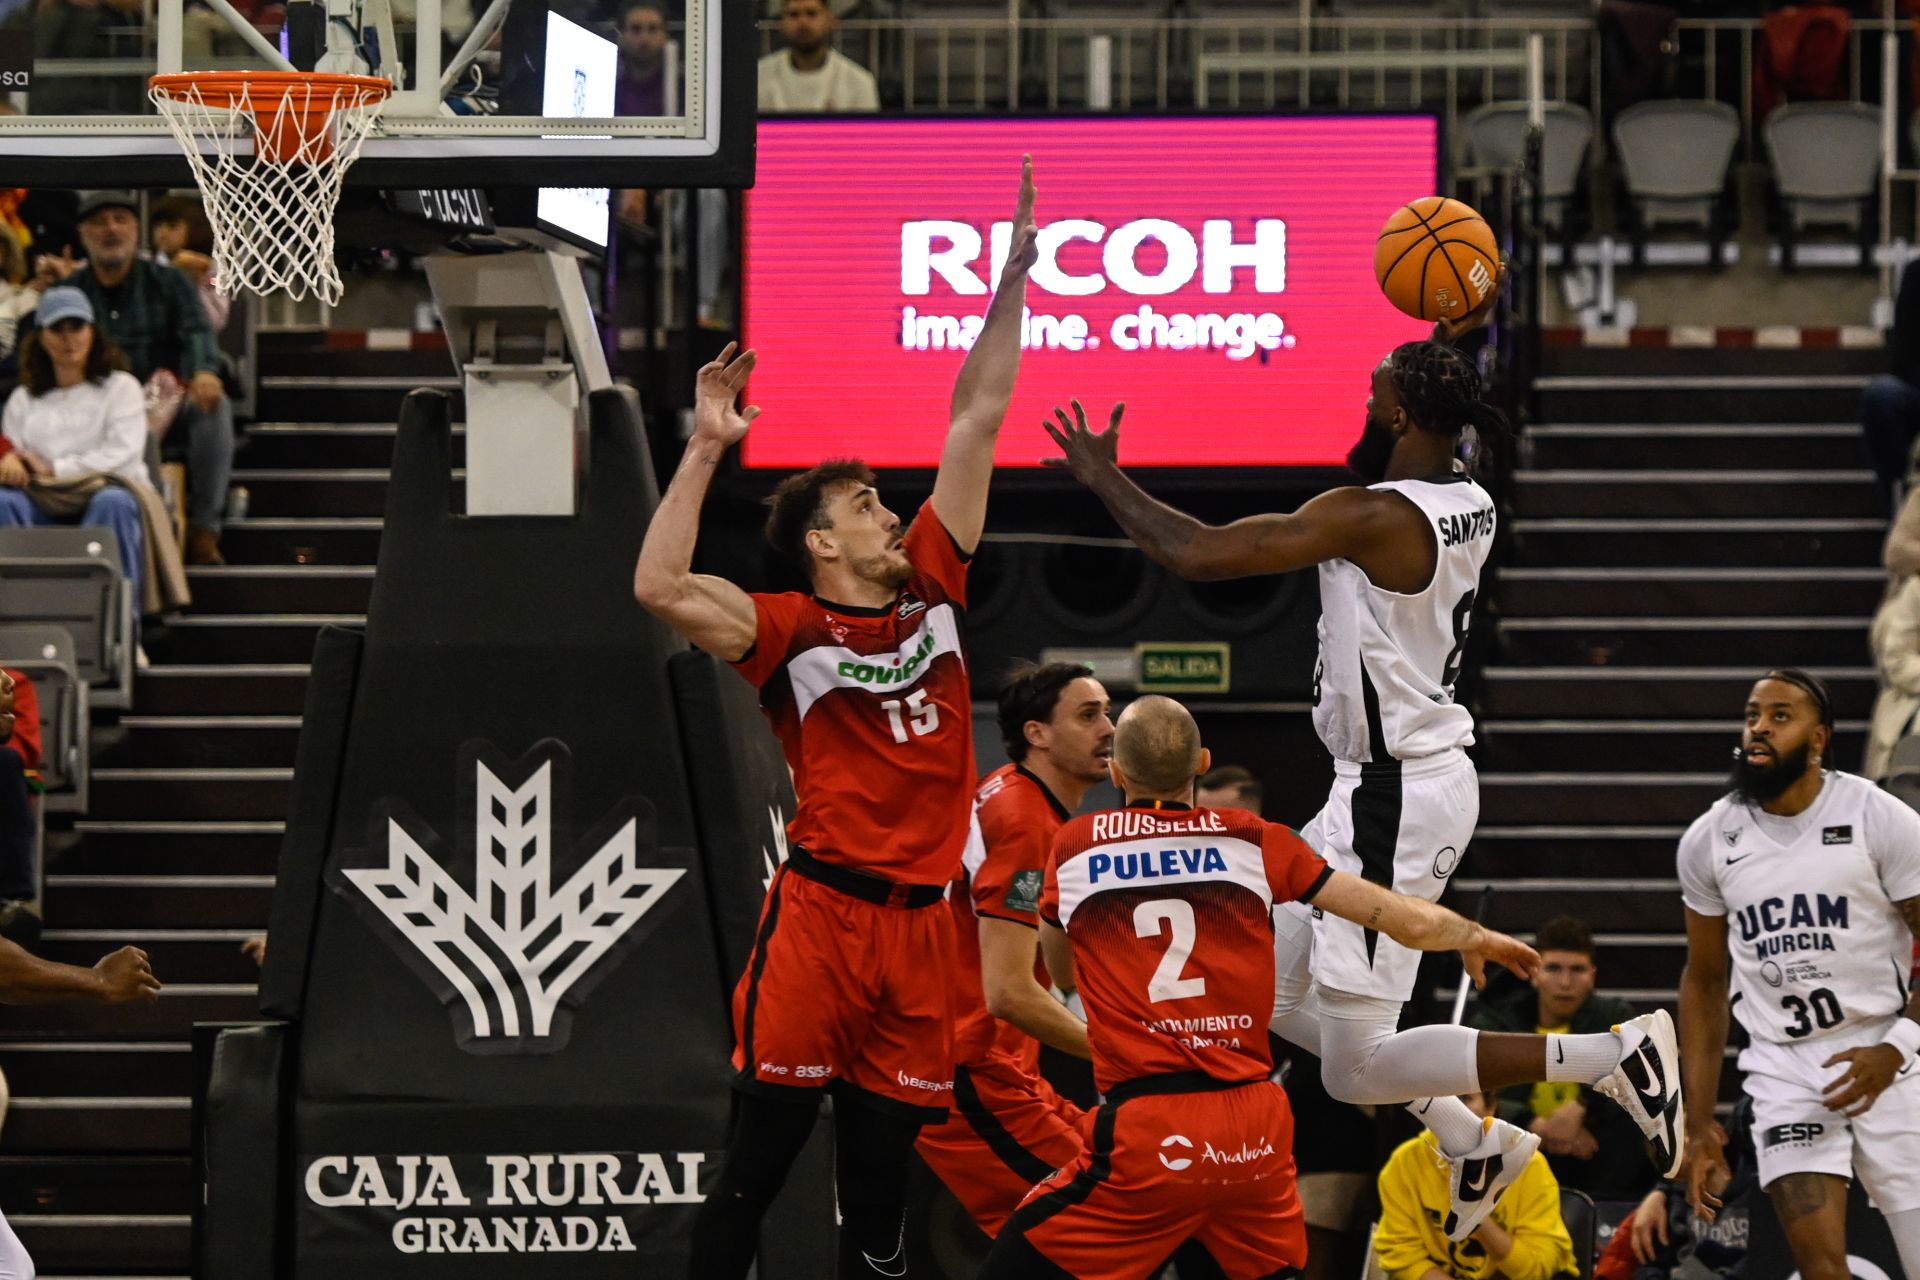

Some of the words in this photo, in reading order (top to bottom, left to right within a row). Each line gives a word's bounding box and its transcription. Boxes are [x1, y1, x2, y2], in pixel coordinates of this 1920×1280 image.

[0, 71, 29, 86] sa
[901, 219, 1286, 295] RICOH
[902, 306, 1100, 351] imaine.
[1111, 305, 1296, 361] change.
[1438, 505, 1494, 547] SANTOS
[1146, 657, 1221, 677] SALIDA
[881, 688, 939, 743] 15
[1093, 811, 1227, 841] ROUSSELLE
[1089, 848, 1227, 884] PULEVA
[1737, 894, 1850, 941] UCAM
[1133, 899, 1205, 1004] 2
[1756, 933, 1836, 961] MURCIA
[1781, 988, 1845, 1038] 30
[304, 1155, 471, 1210] CAJA
[486, 1152, 707, 1206] RURAL
[392, 1216, 637, 1253] GRANADA
